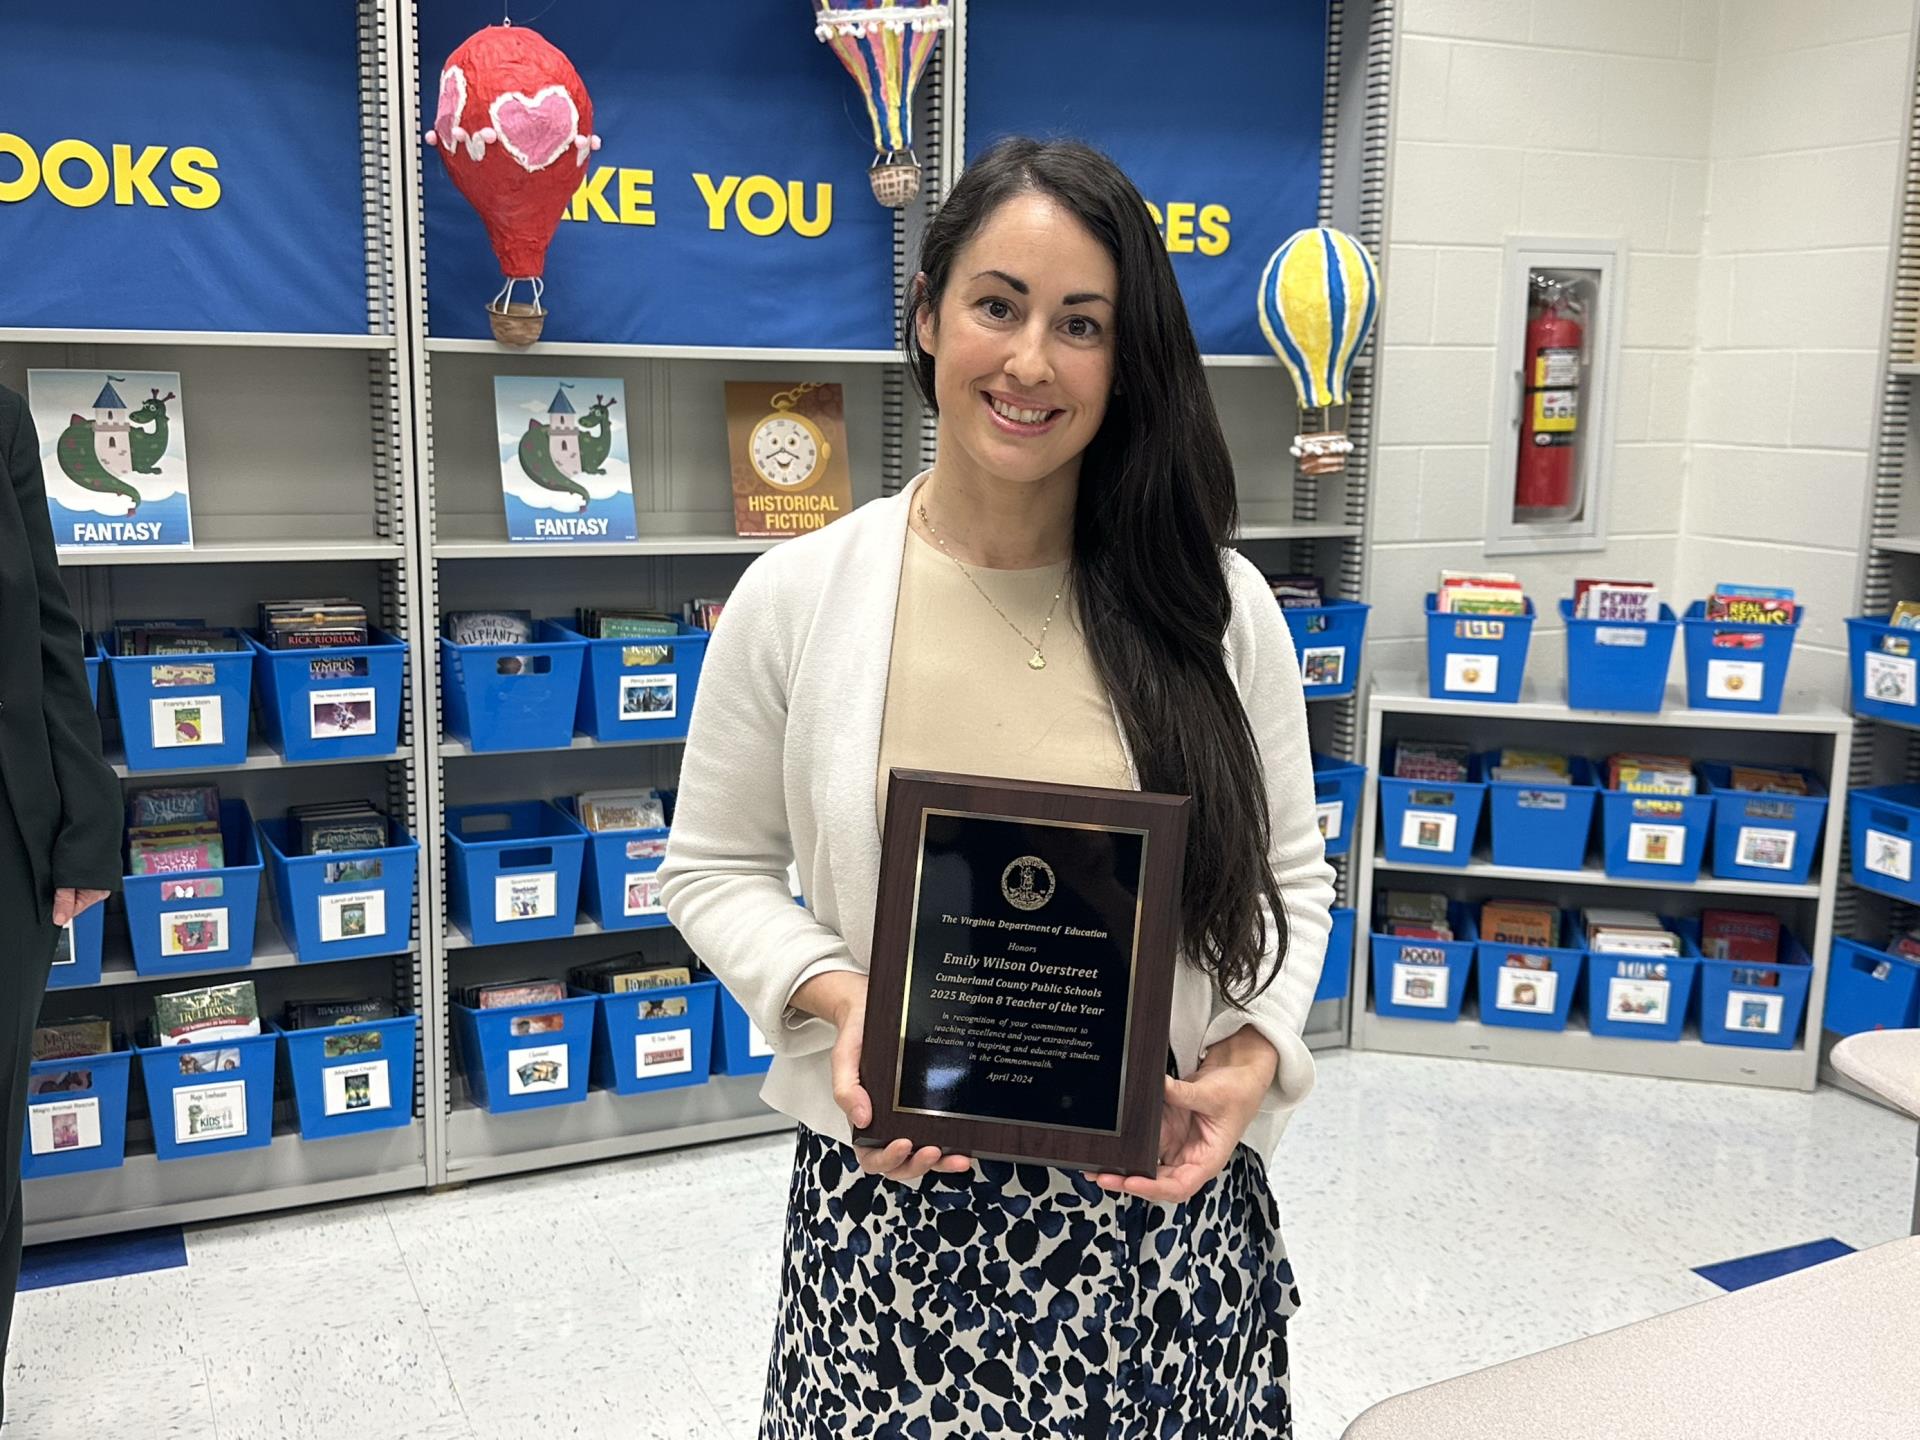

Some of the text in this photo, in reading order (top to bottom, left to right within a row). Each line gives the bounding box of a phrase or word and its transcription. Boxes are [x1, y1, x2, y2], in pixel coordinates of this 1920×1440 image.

[691, 173, 833, 238] YOU
[748, 495, 839, 512] HISTORICAL
[534, 518, 609, 536] FANTASY
[765, 513, 826, 530] FICTION
[73, 522, 162, 542] FANTASY
[1600, 591, 1648, 605] PENNY
[288, 635, 313, 644] RICK
[314, 634, 361, 644] RIORDAN
[941, 914, 1108, 939] The Virginia Department of Education
[1007, 942, 1037, 953] Honors
[943, 952, 1099, 979] Emily Wilson Overstreet
[935, 972, 1103, 998] Cumberland County Public Schools
[930, 989, 1105, 1016] 2025 Region 8 Teacher of the Year
[942, 1012, 1089, 1035] In recognition of your commitment to
[934, 1024, 1094, 1049] teaching excellence and your extraordinary
[924, 1035, 1101, 1062] dedication to inspiring and educating students
[968, 1052, 977, 1061] in
[979, 1053, 991, 1062] the
[986, 1071, 1034, 1084] April 2024
